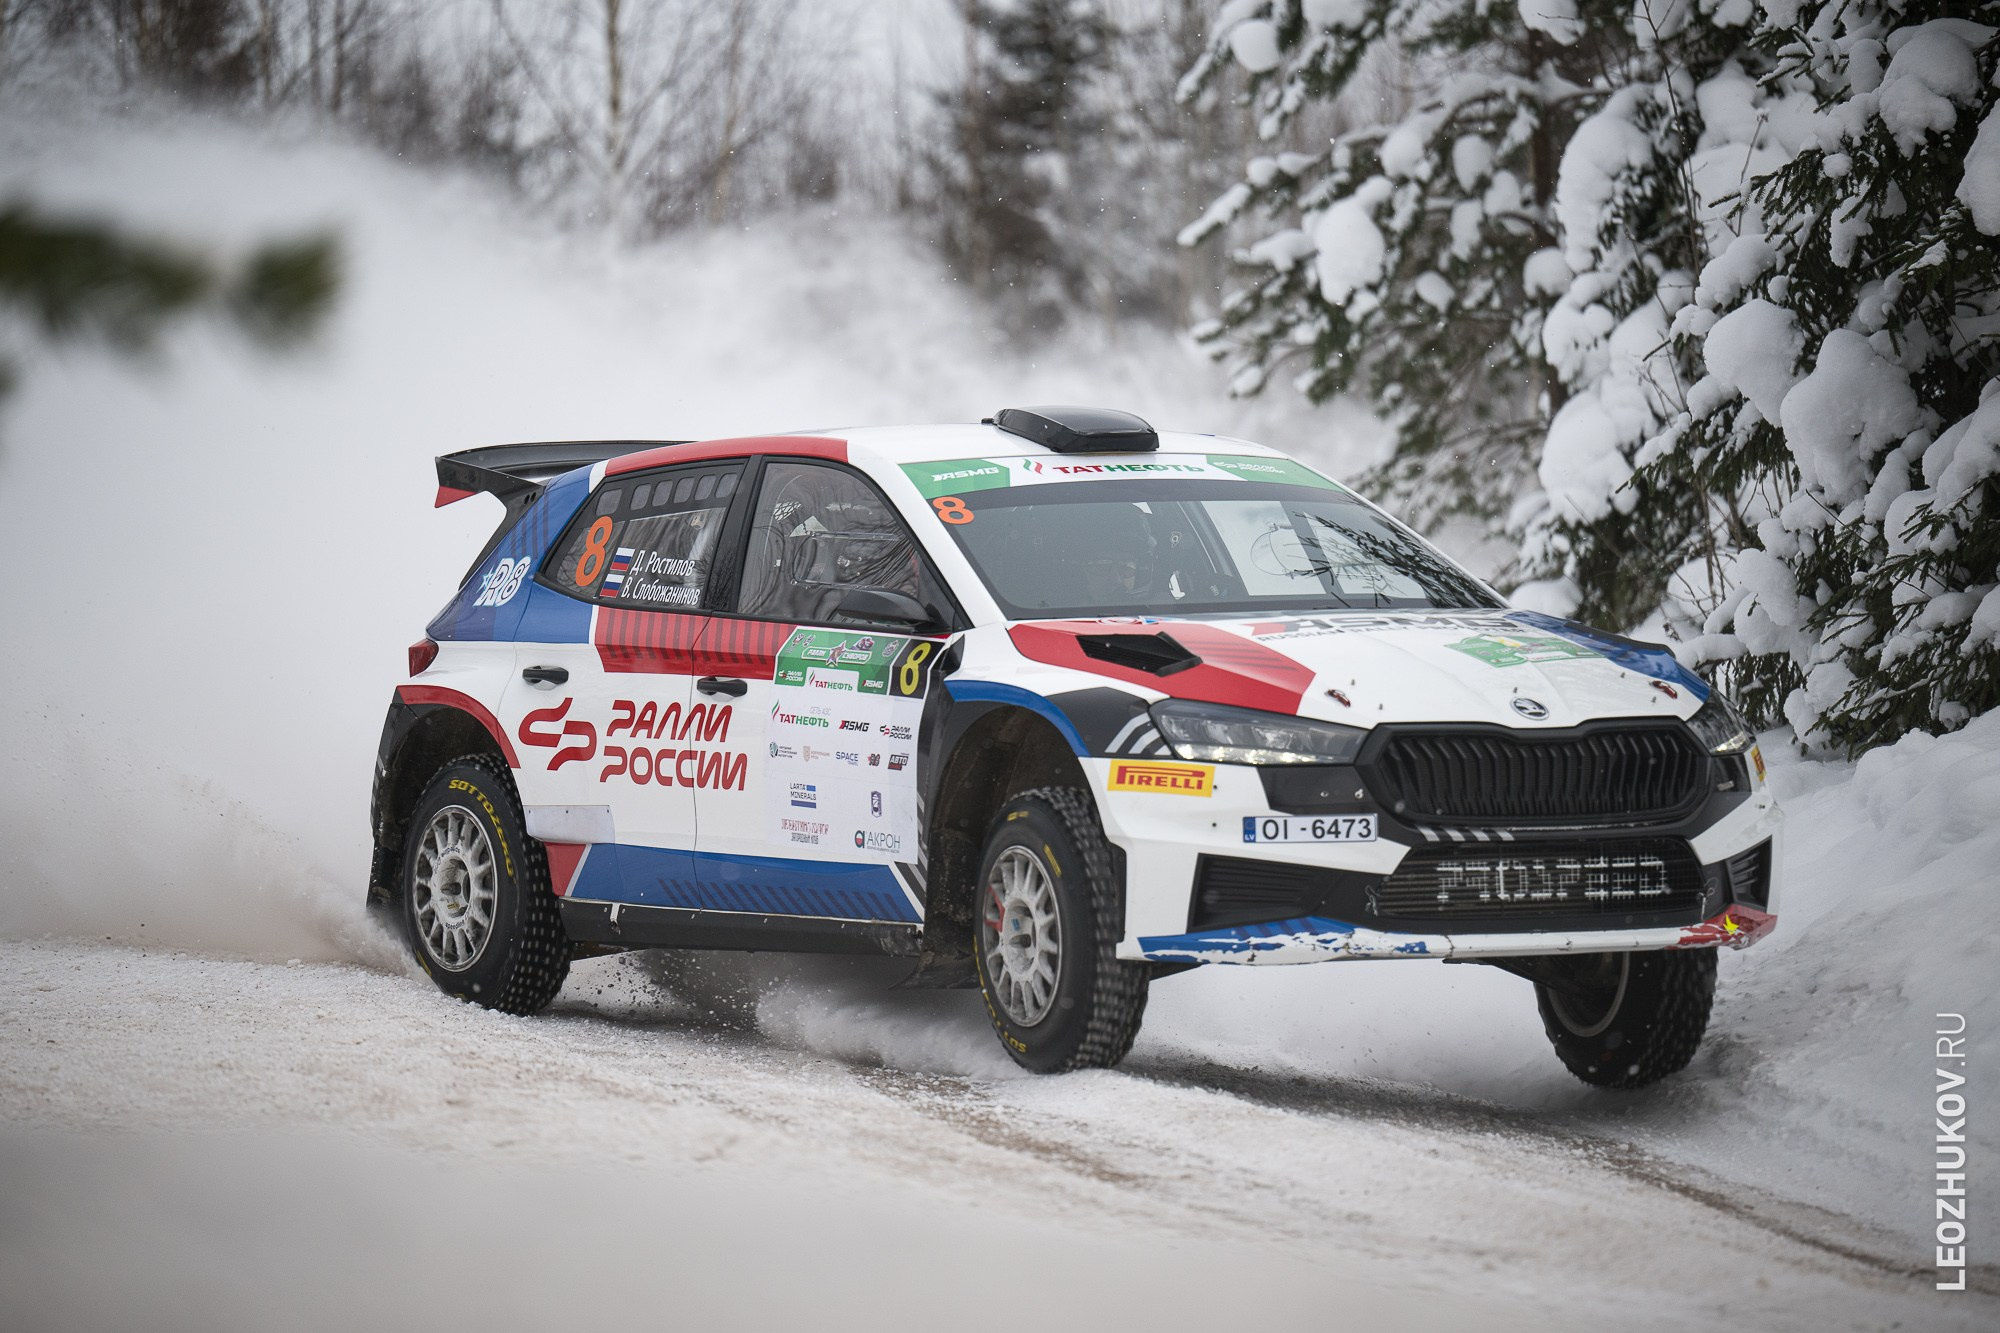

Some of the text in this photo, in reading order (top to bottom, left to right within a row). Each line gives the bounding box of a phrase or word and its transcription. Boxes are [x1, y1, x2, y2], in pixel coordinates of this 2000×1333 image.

[1052, 464, 1205, 475] ТАТНЕФТЬ
[932, 496, 975, 525] 8
[575, 516, 613, 587] 8
[629, 549, 696, 577] Д. Ростилов
[621, 576, 701, 606] В. Слобожанинов
[900, 642, 931, 696] 8
[815, 680, 853, 691] ТАТНЕФТЬ
[606, 699, 733, 743] РАЛЛИ
[779, 713, 829, 728] ТАТНЕФТЬ
[599, 745, 748, 791] РОССИИ
[835, 751, 859, 762] SPACE
[790, 782, 806, 791] LARTA
[1116, 765, 1206, 790] PIRELLI
[790, 791, 816, 801] MINERALS
[866, 831, 901, 849] АКРОН
